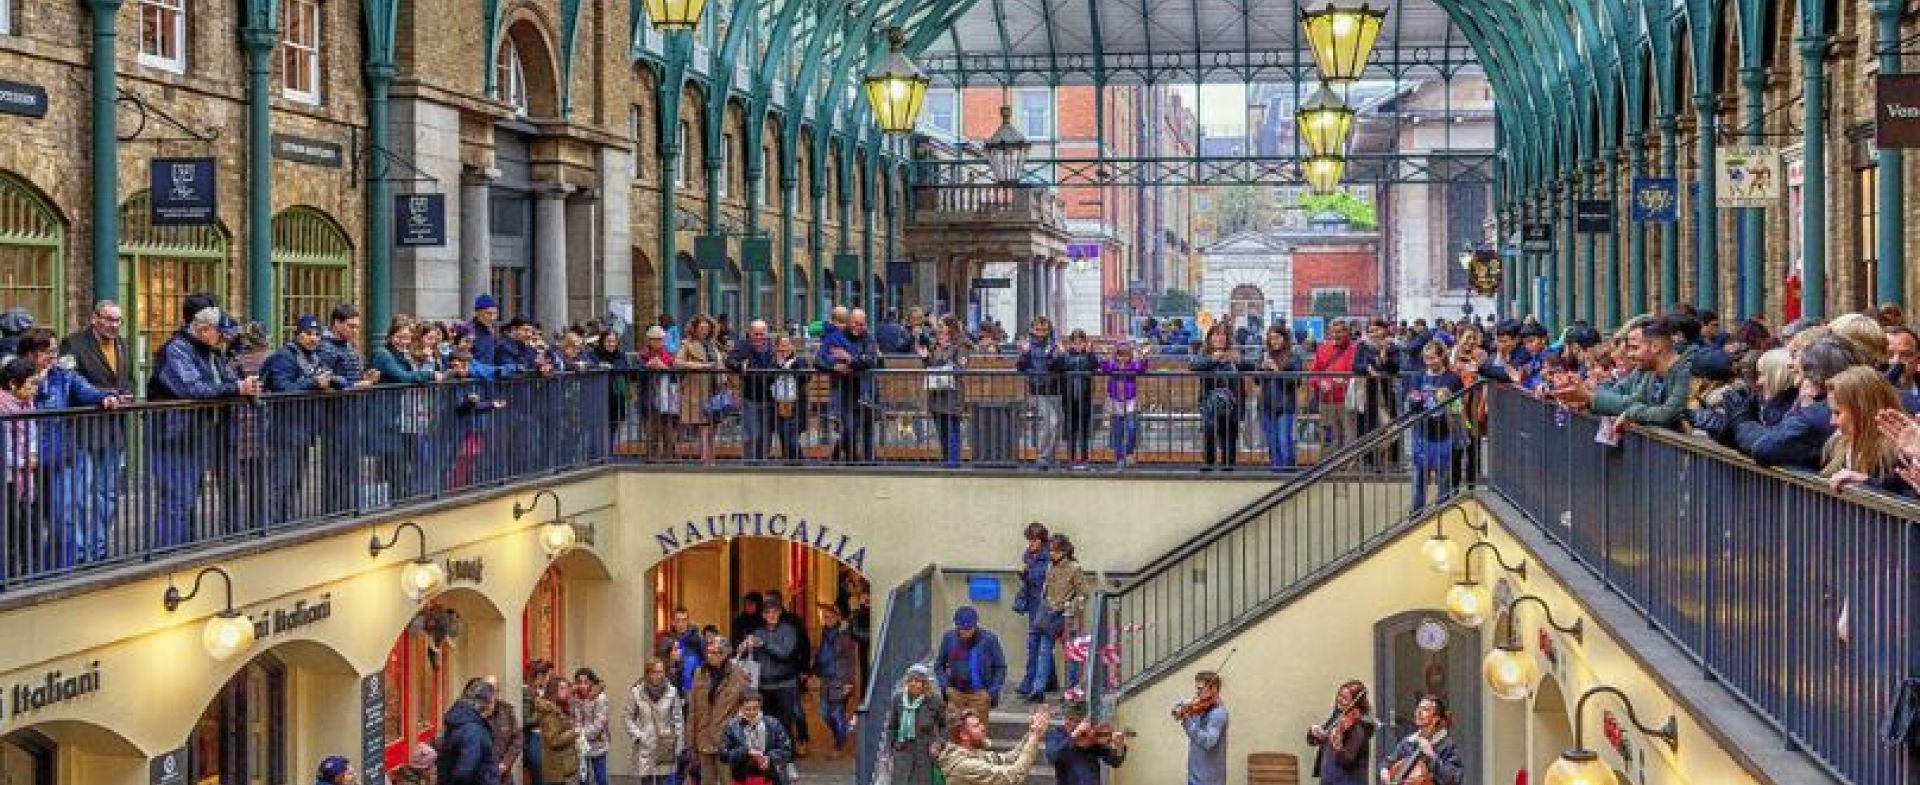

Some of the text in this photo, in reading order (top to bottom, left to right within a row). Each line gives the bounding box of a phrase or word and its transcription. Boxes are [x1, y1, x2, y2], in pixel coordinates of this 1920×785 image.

[655, 513, 866, 570] NAUTICALIA
[274, 591, 331, 633] Italiani
[13, 660, 99, 713] Italiani
